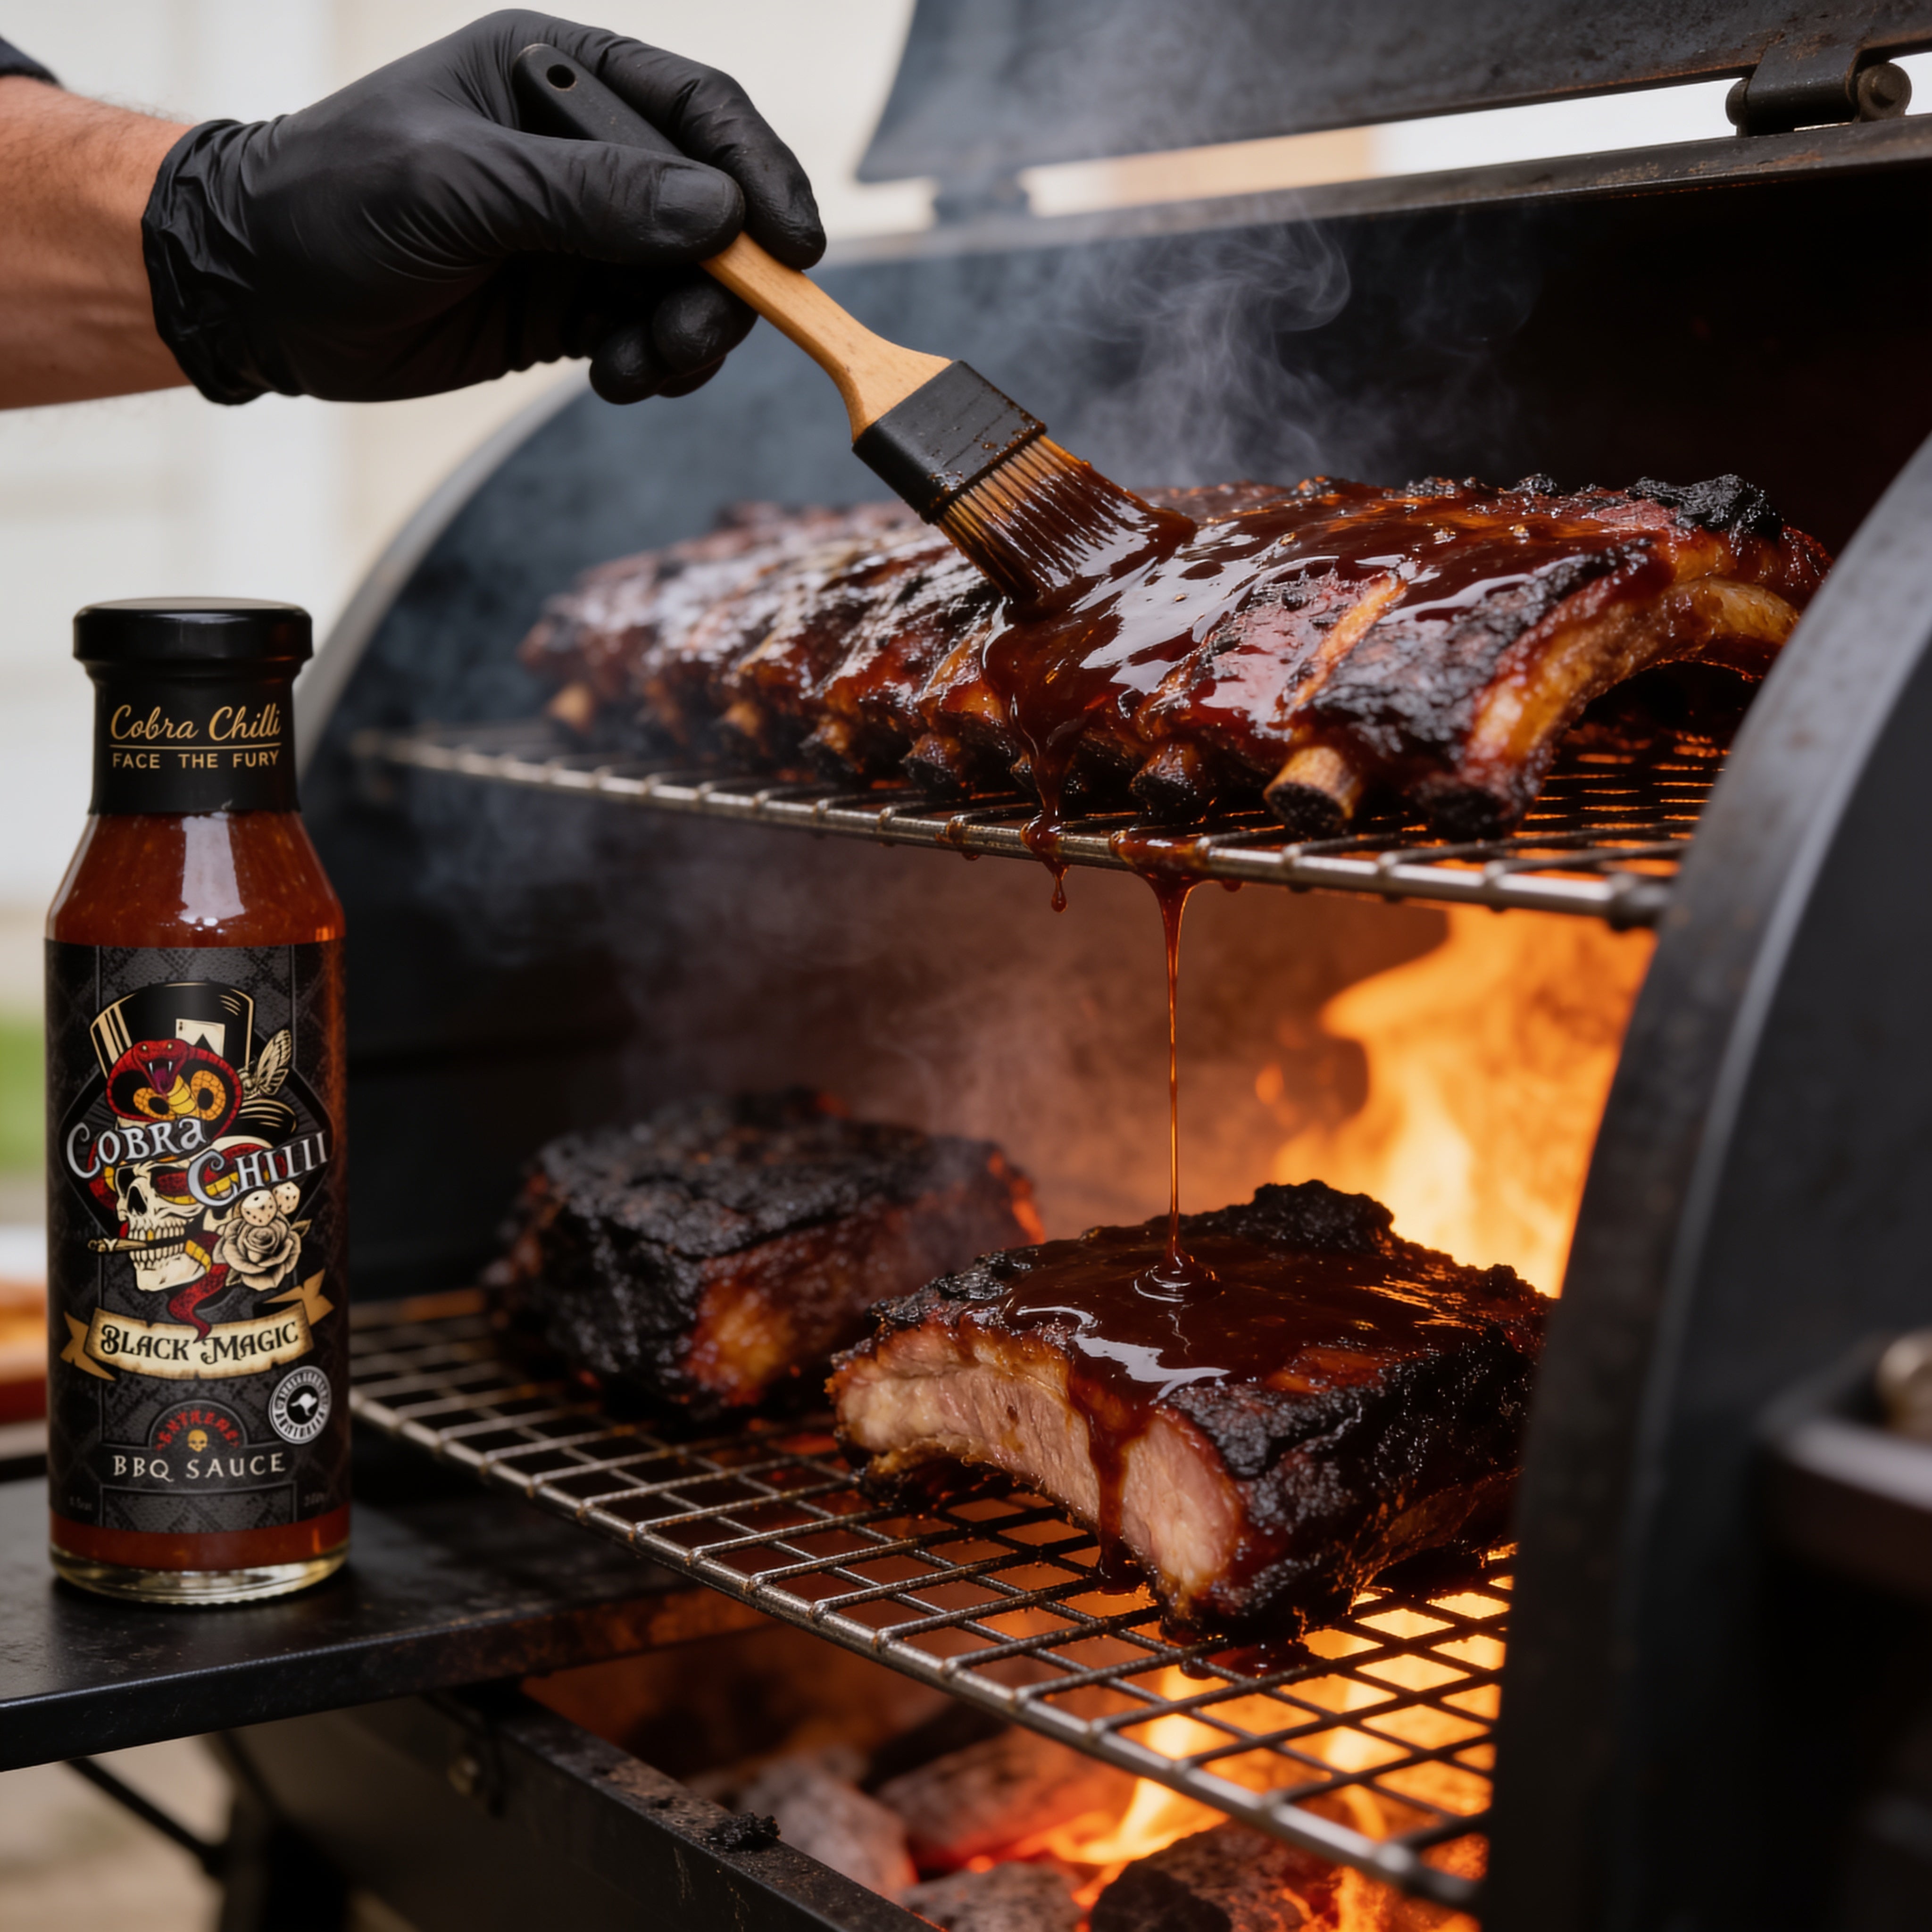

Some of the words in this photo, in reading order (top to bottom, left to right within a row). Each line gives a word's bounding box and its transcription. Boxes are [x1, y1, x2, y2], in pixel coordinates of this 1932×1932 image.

[110, 704, 199, 740] Cobra
[208, 703, 282, 741] Chilli
[112, 753, 161, 769] FACE
[178, 753, 219, 768] THE
[233, 749, 280, 767] FURY
[67, 1117, 207, 1179] COBRA
[100, 1324, 190, 1361] BLACK
[200, 1321, 299, 1365] MAGIC
[112, 1455, 175, 1482] BBQ
[186, 1452, 286, 1479] SAUCE
